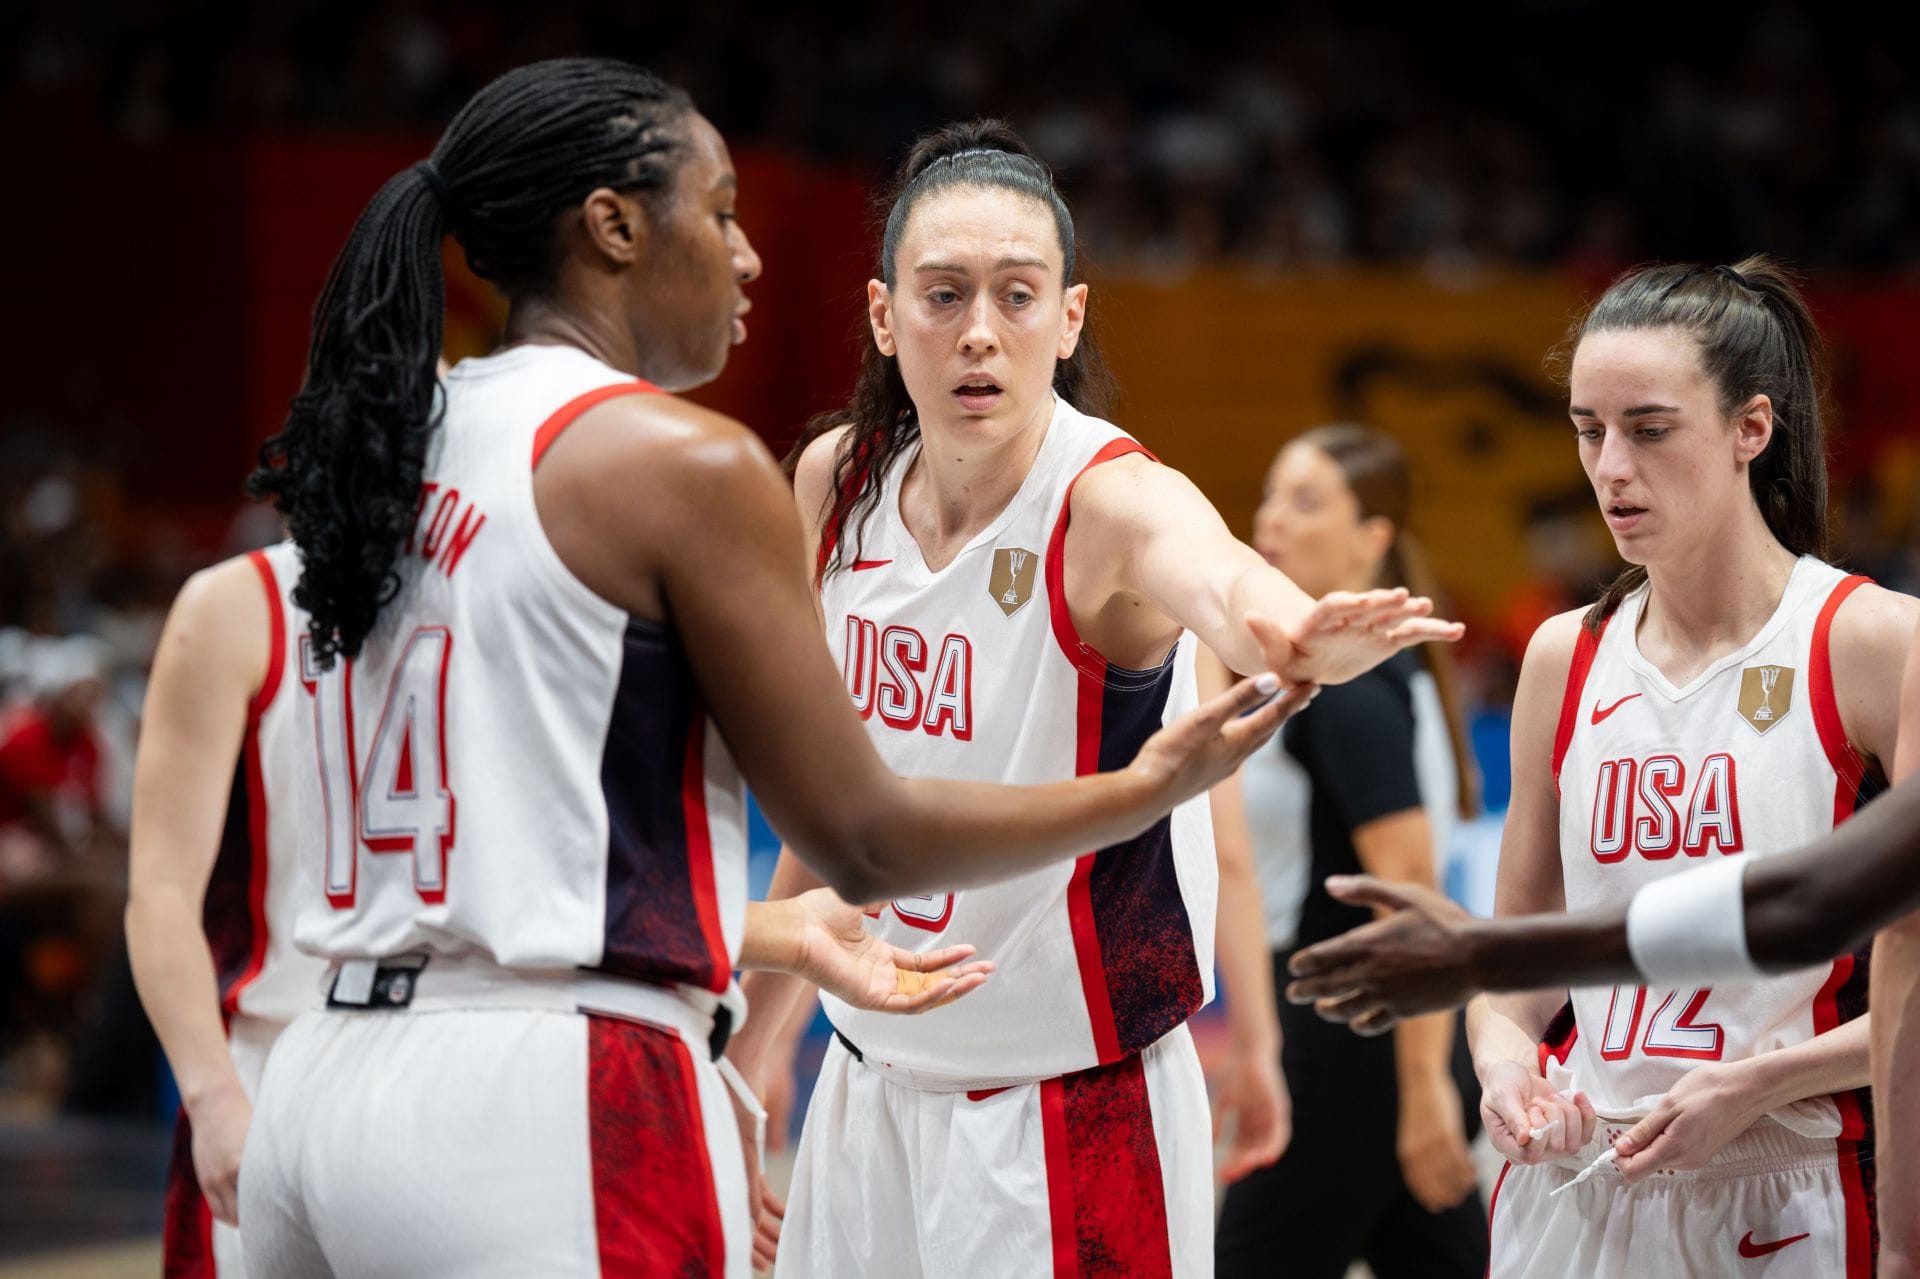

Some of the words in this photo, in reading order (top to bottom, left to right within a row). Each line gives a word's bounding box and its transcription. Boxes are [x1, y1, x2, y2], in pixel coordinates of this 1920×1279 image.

[844, 614, 973, 741] USA
[300, 625, 456, 910] 14
[1590, 752, 1744, 864] USA
